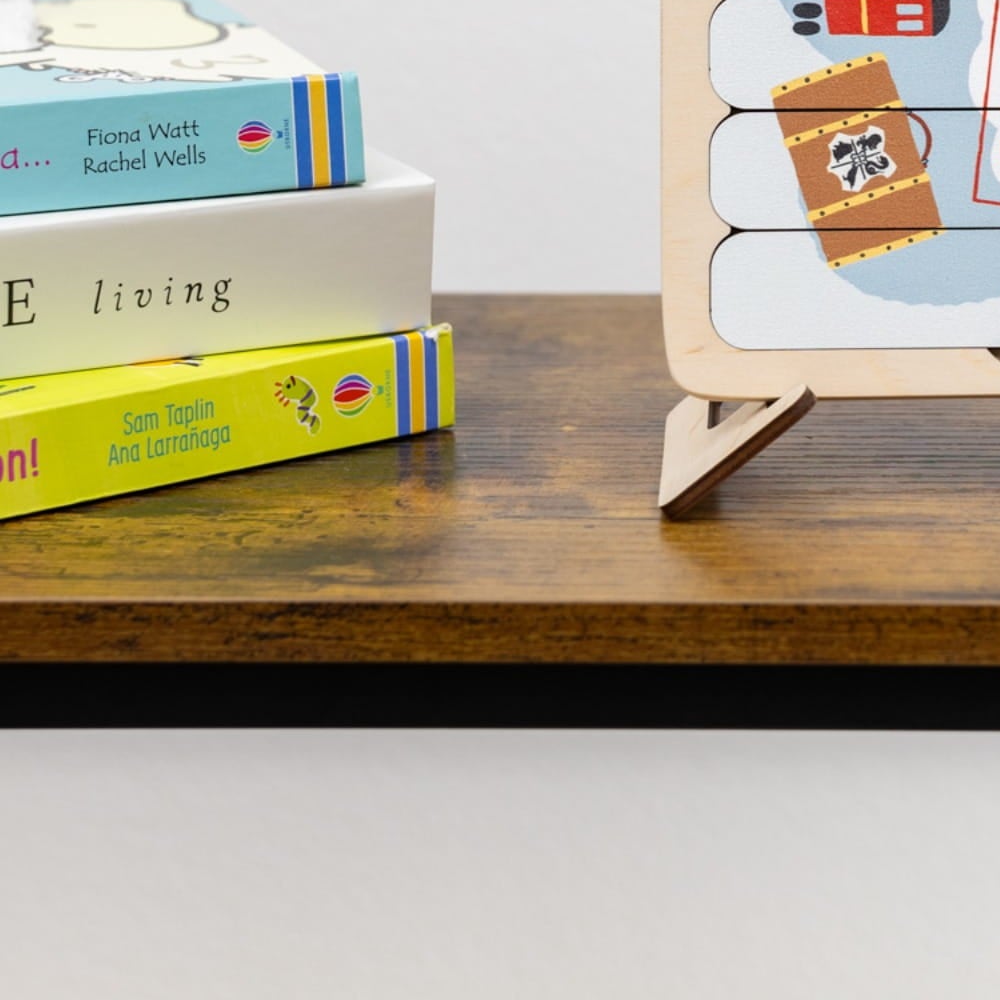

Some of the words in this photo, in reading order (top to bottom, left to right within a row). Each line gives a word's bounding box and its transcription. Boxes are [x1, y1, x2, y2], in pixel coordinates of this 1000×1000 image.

[87, 126, 141, 147] Fiona
[148, 119, 201, 141] Watt
[83, 149, 147, 175] Rachel
[154, 144, 207, 169] Wells
[93, 276, 233, 315] living
[123, 411, 159, 436] Sam
[165, 398, 215, 429] Taplin
[108, 442, 141, 467] Ana
[147, 424, 231, 459] Larrañaga
